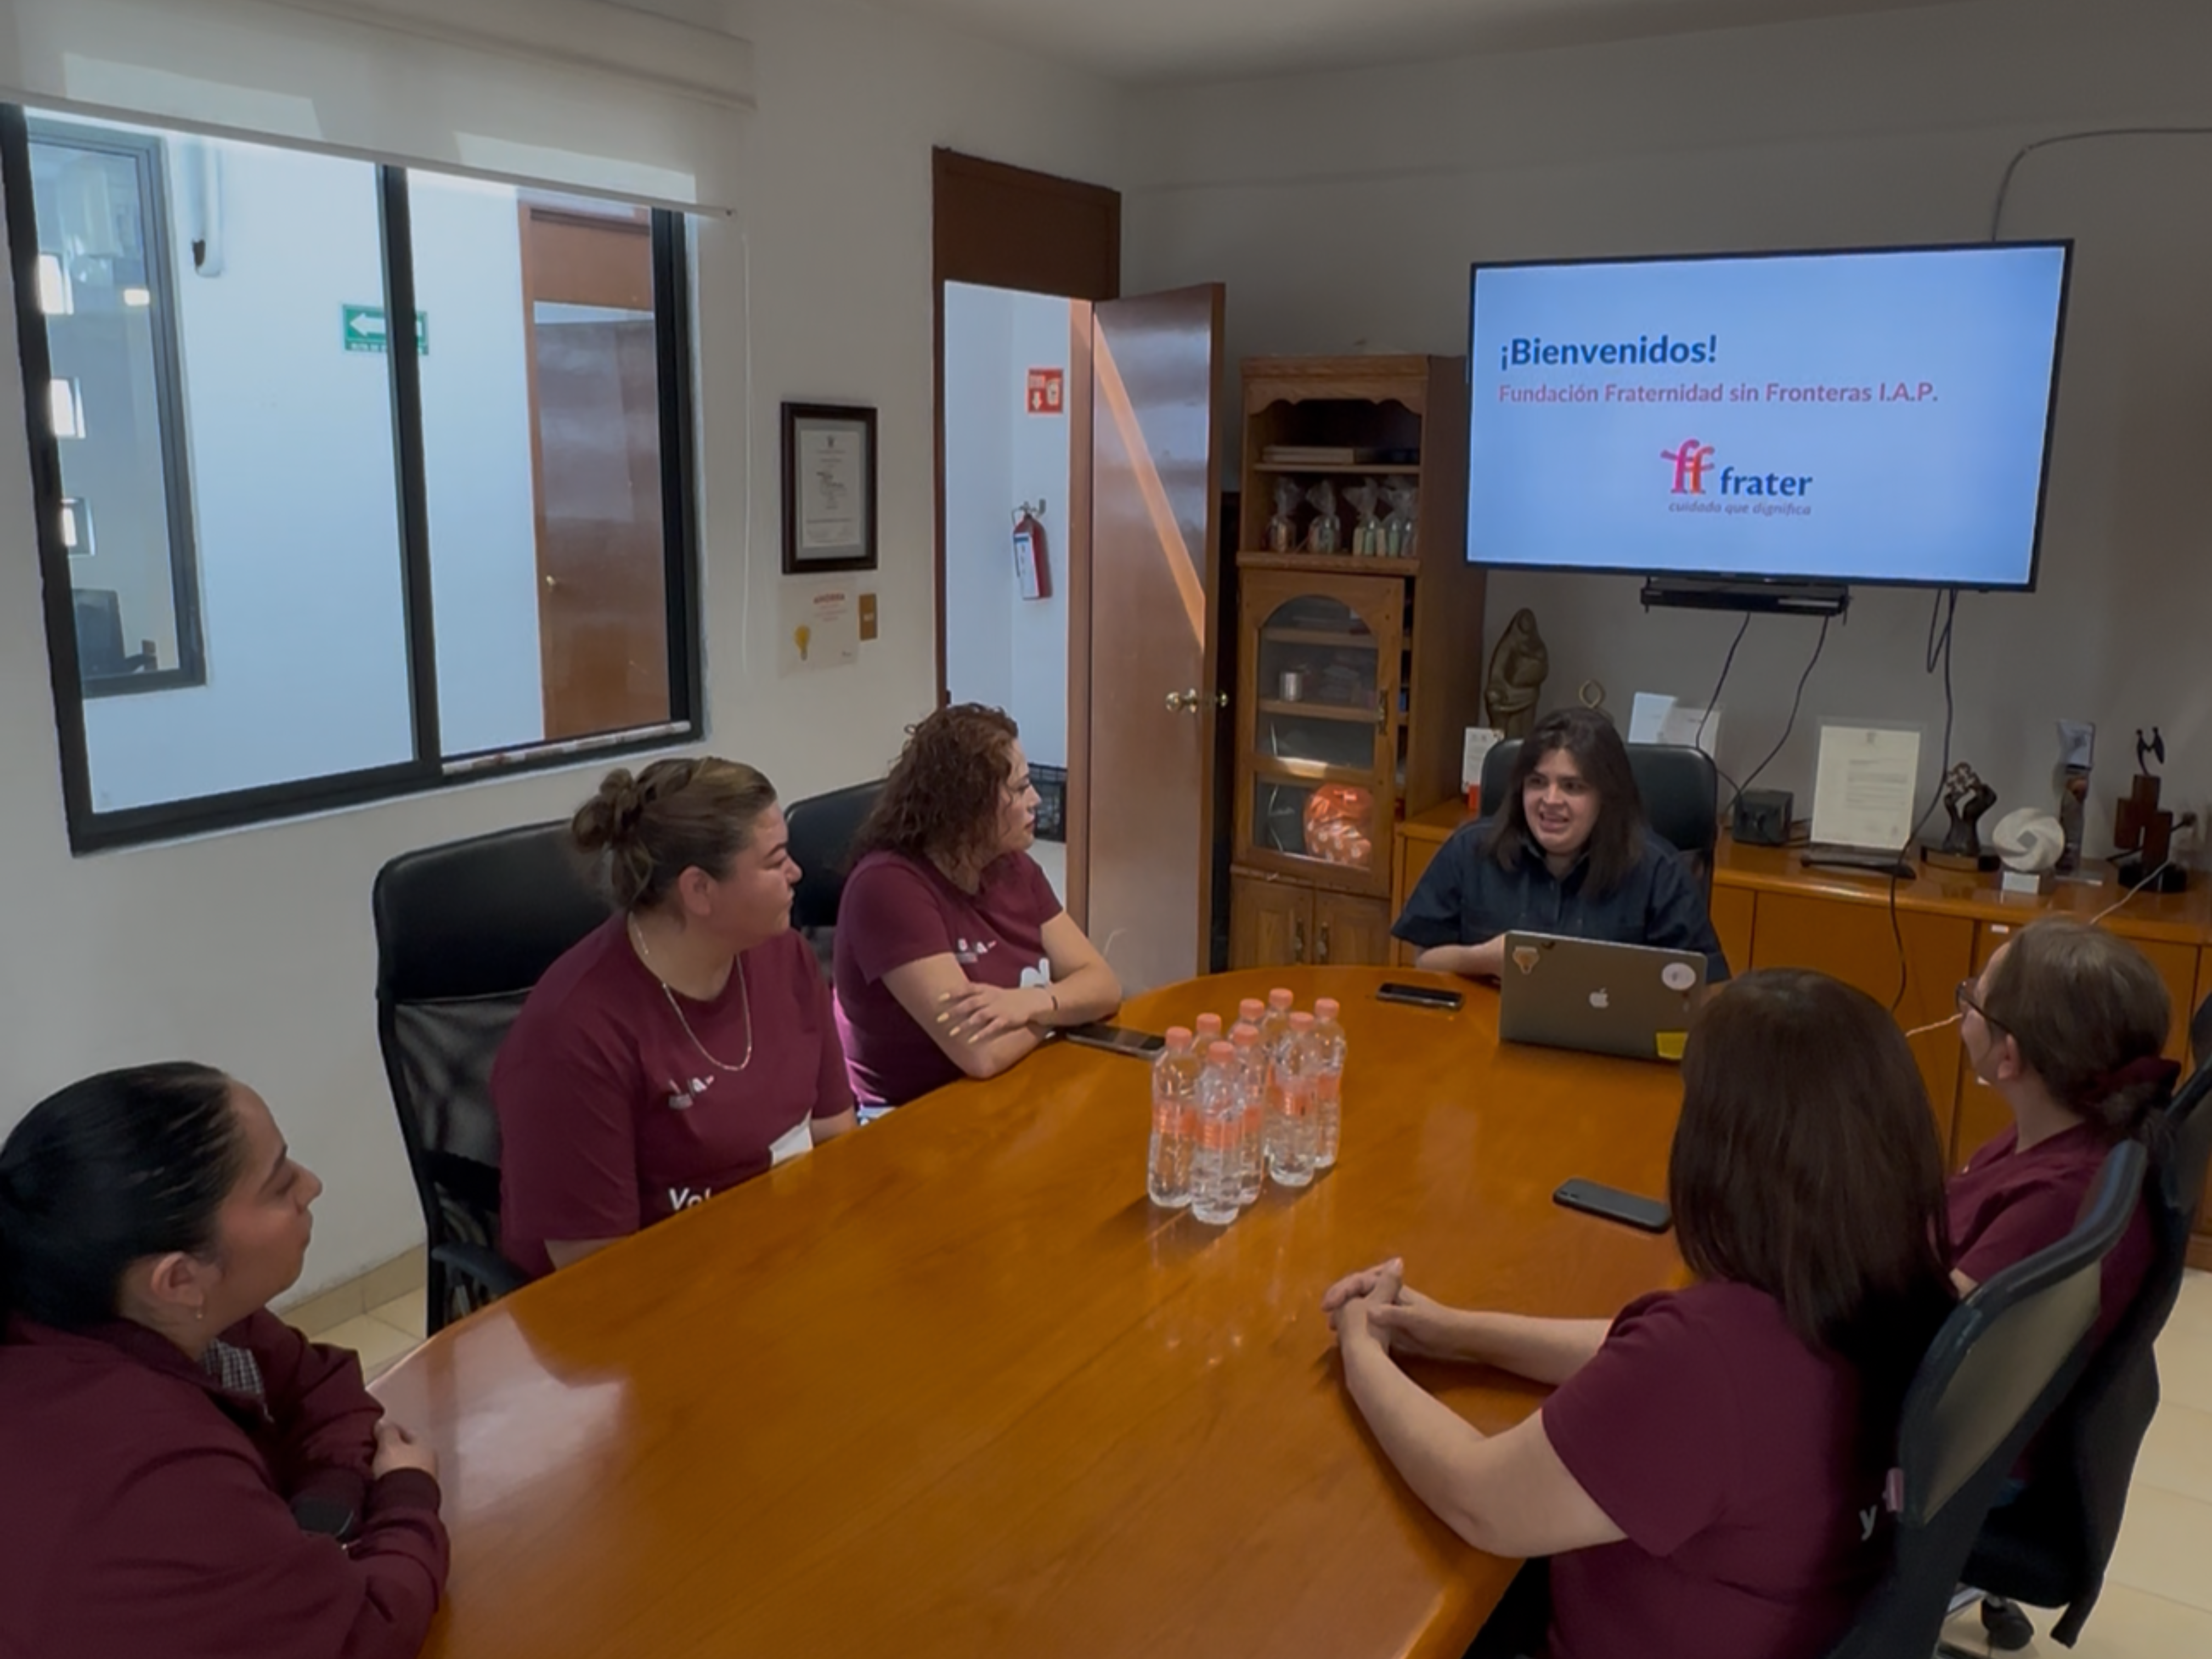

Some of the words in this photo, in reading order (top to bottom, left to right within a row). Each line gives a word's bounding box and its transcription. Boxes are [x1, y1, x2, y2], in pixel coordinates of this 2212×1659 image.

[1502, 335, 1717, 371] ¡Bienvenidos!
[1499, 383, 1599, 402] Fundación
[1604, 382, 1723, 402] Fraternidad
[1729, 383, 1759, 402] sin
[1765, 383, 1872, 402] Fronteras
[1879, 382, 1938, 402] I.A.P.
[1720, 466, 1813, 496] frater
[1668, 501, 1722, 513] cuidado
[1725, 503, 1750, 515] que
[1752, 501, 1812, 516] dignifica
